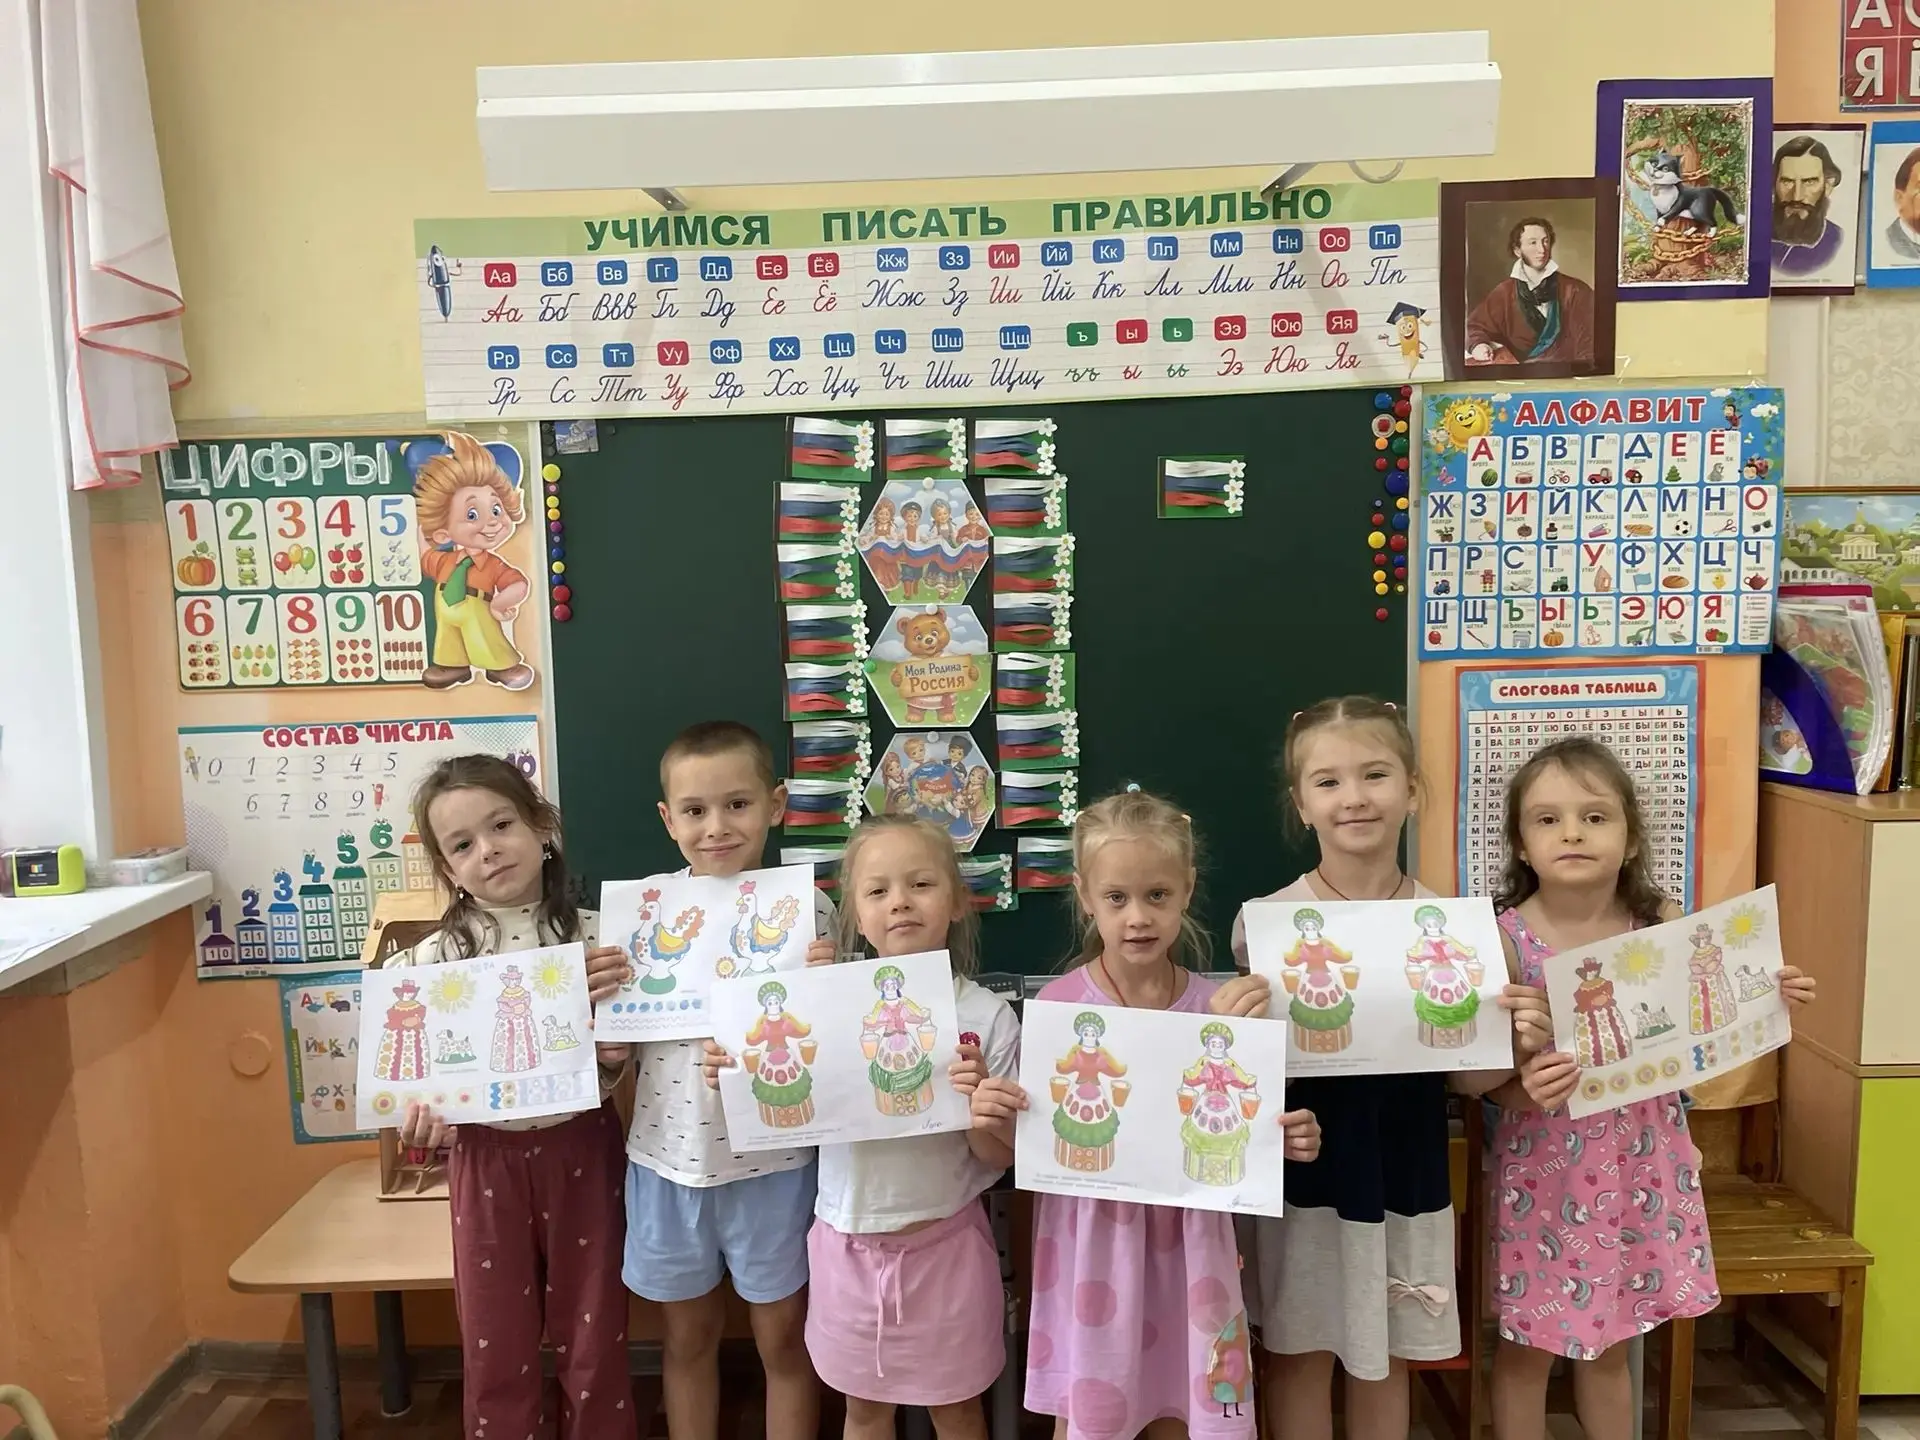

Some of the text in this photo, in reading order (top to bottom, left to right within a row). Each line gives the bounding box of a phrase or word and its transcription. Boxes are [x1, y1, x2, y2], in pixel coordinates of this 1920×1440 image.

[1853, 47, 1884, 96] Я
[585, 189, 1332, 250] УЧИМСЯ ПИСАТЬ ПРАВИЛЬНО
[490, 231, 1395, 283] Аа Бб Вв Гг Дд Ее Ёё Жж Зз Ии Йй Кк Лл Мм Нн Оо Пп
[482, 294, 522, 323] Аа
[539, 293, 579, 322] Бб
[651, 289, 679, 318] Гг
[701, 288, 736, 328] Дд
[762, 287, 786, 316] Ее
[814, 280, 837, 312] Ёё
[862, 280, 925, 308] Жж
[943, 277, 969, 316] Зз
[990, 276, 1022, 305] Ии
[1041, 269, 1075, 301] Йй
[1092, 270, 1126, 299] Кк
[1144, 270, 1183, 296] Лл
[1198, 265, 1253, 295] Мм
[1269, 262, 1306, 291] Нн
[1322, 260, 1349, 288] Оо
[1364, 255, 1407, 284] Пп
[494, 316, 1352, 369] Рр Сс Тт Уу Фф Хх Цц Чч Шш Щщ ъ ы ь Ээ Юю Яя
[1516, 398, 1706, 426] АЛФАВИТ
[1472, 430, 1725, 460] А Б В Г Д Е Ё
[164, 441, 392, 495] ЦИФРЫ
[1429, 487, 1767, 517] Ж З И Й К Л М Н О
[179, 499, 406, 540] 1 2 3 4 5
[1429, 542, 1760, 570] П Р С Т У Ф Х Ц Ч
[184, 594, 421, 636] 6 7 8 9 10
[1428, 602, 1447, 624] Ш
[1464, 601, 1487, 624] Щ
[1504, 600, 1524, 621] Ъ
[1542, 599, 1564, 620] Ы
[1584, 598, 1599, 619] Ь
[1622, 597, 1645, 619] Э
[1659, 597, 1685, 619] Ю
[1704, 596, 1722, 618] Я
[905, 665, 925, 677] Моя
[1499, 682, 1656, 697] СЛОГОВАЯ ТАБЛИЦА
[263, 722, 454, 747] СОСТАВ ЧИСЛА
[208, 753, 398, 776] 0 1 2 3 4 5
[247, 791, 363, 812] 6 7 8 9
[337, 834, 359, 864] 5
[370, 822, 393, 849] 6
[303, 854, 325, 883] 4
[273, 872, 293, 902] 3
[242, 888, 260, 917] 2
[206, 904, 222, 933] 1
[1537, 1155, 1568, 1177] LOVE
[1557, 1225, 1591, 1256] LOVE
[1531, 1299, 1565, 1320] LOVE
